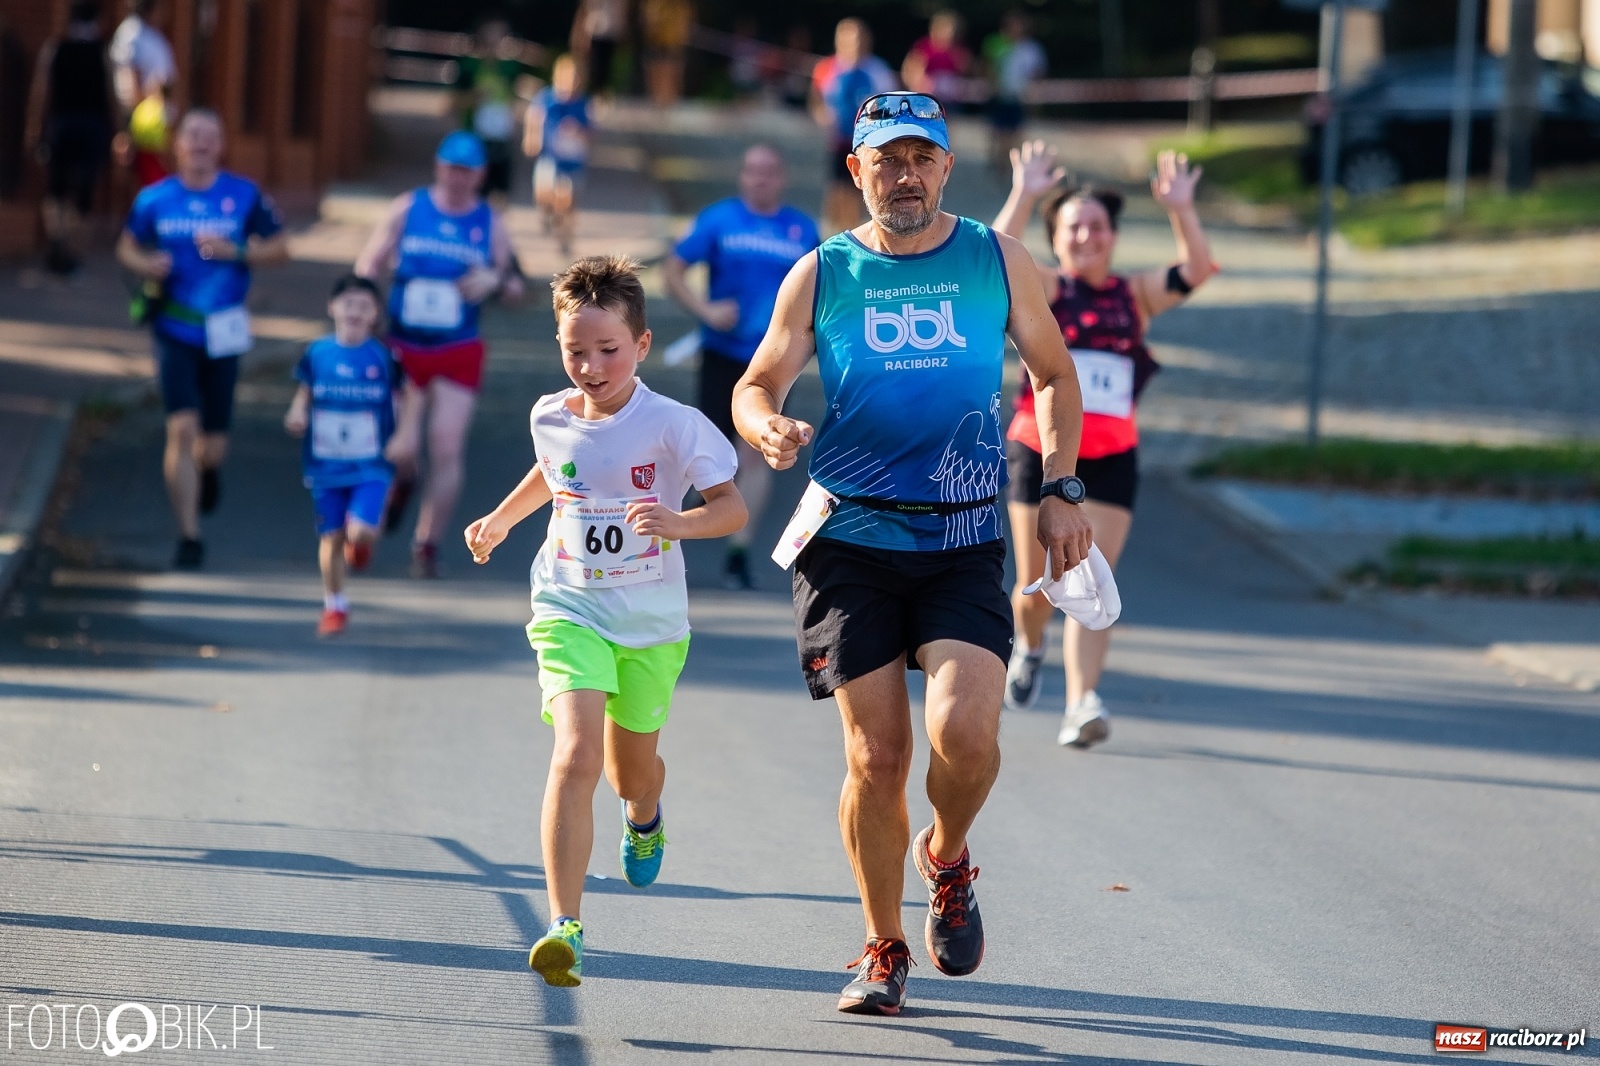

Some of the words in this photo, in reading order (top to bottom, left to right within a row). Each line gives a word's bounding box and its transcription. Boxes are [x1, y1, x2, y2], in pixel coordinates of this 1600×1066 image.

[864, 281, 960, 300] BiegamBoLubię
[864, 300, 967, 353] bbl
[885, 356, 948, 371] RACIBÓRZ
[585, 525, 623, 555] 60
